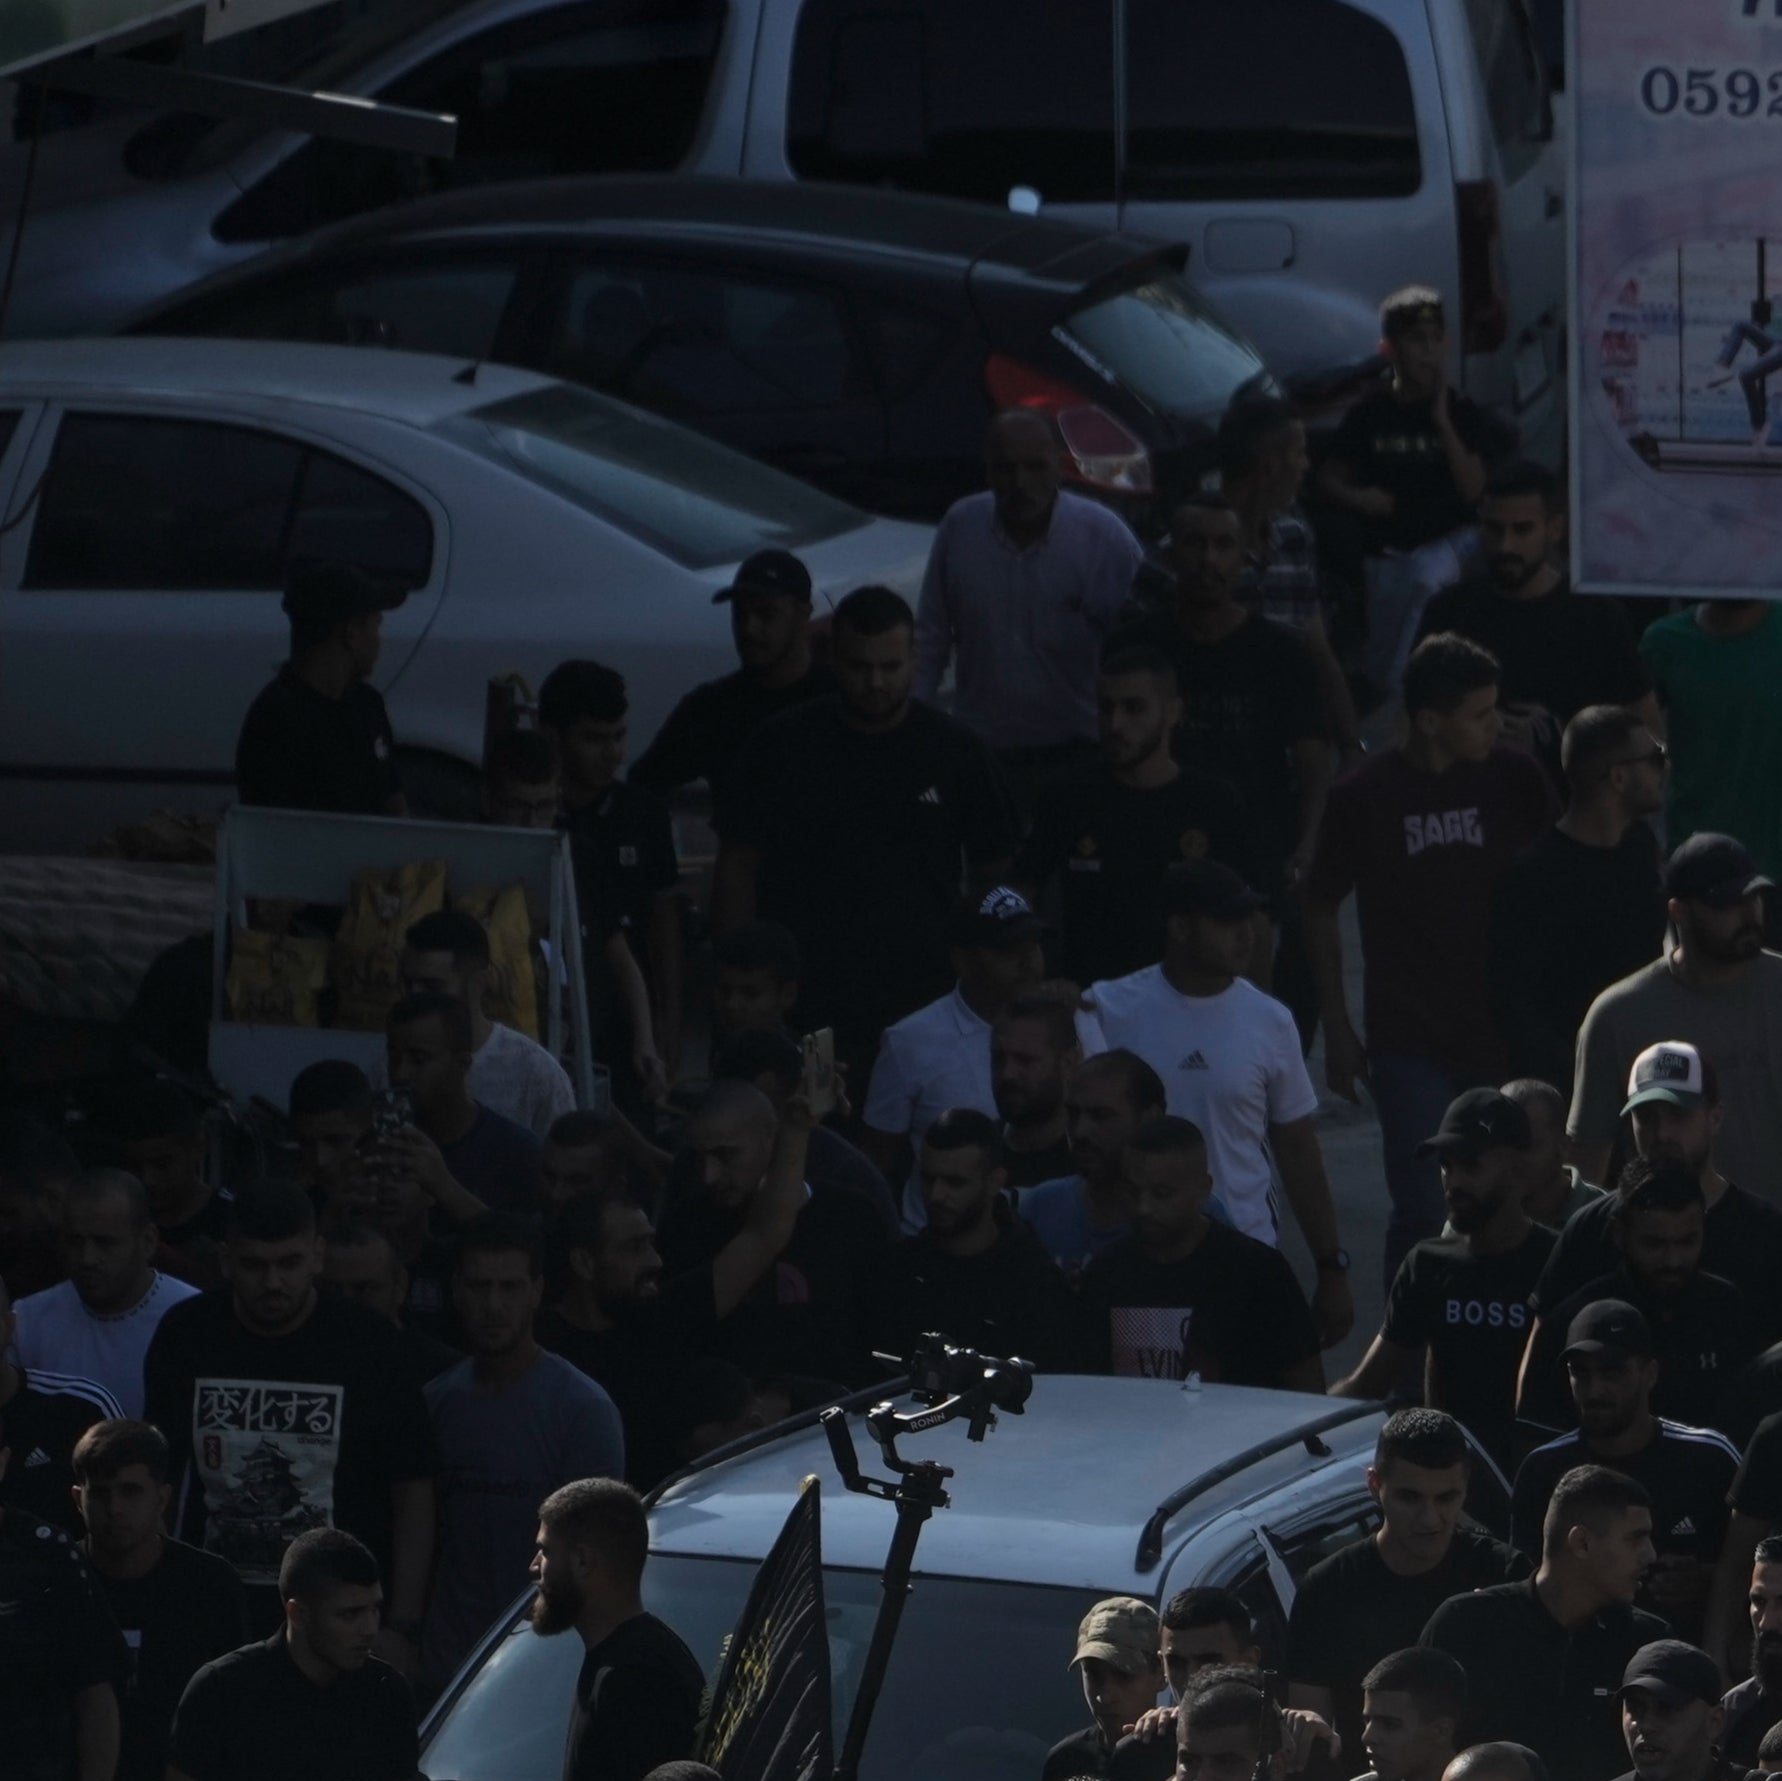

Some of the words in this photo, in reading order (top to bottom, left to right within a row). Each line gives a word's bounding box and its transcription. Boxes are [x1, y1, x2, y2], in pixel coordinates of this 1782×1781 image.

[1404, 807, 1484, 856] SAGE
[1446, 1299, 1526, 1328] BOSS
[203, 1388, 333, 1433] 変化する
[910, 1413, 946, 1432] RONIN
[297, 1436, 333, 1446] change
